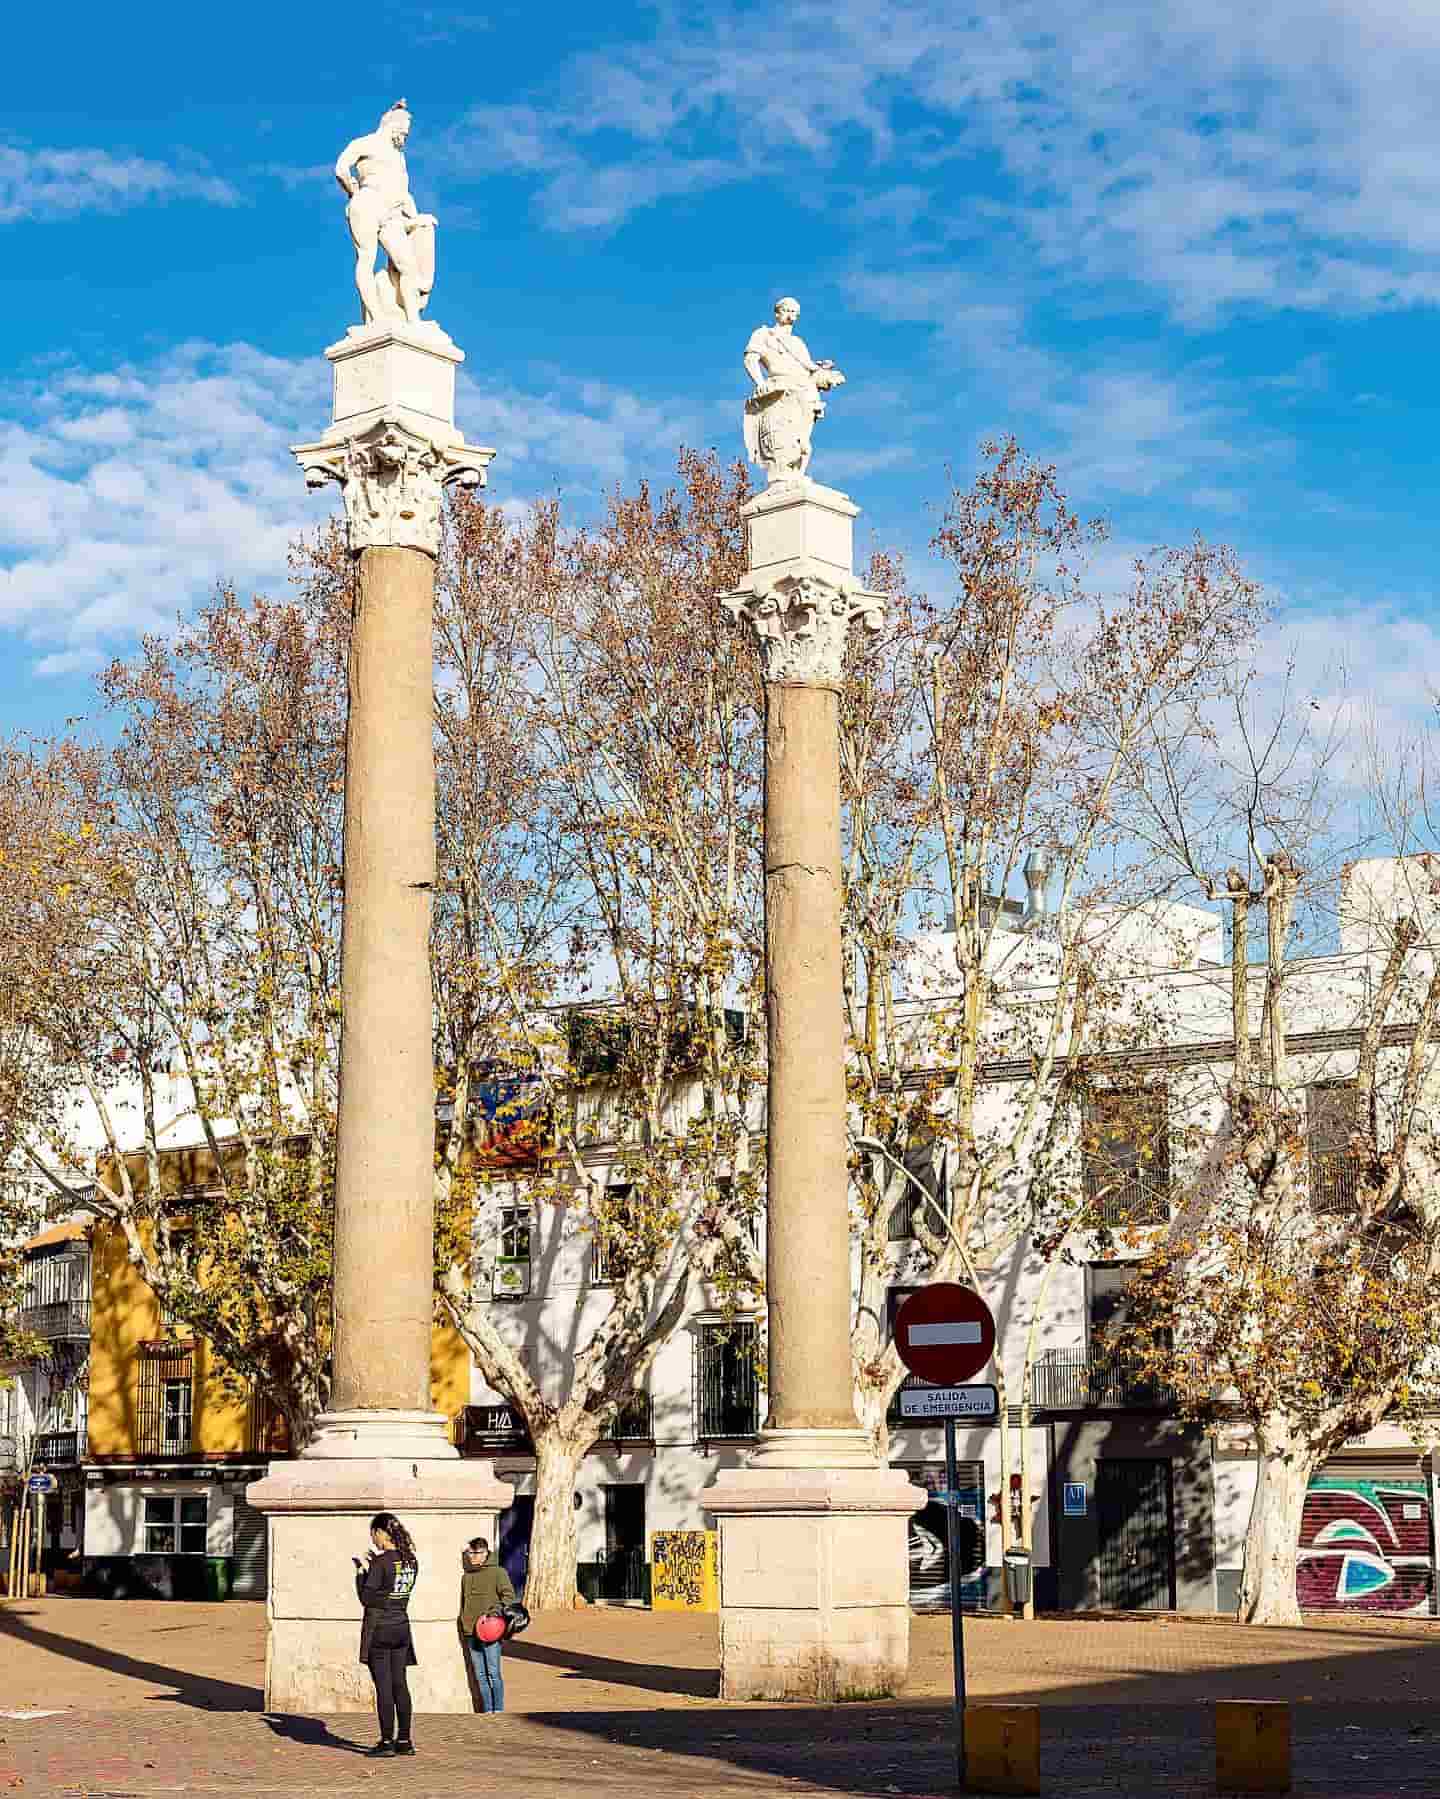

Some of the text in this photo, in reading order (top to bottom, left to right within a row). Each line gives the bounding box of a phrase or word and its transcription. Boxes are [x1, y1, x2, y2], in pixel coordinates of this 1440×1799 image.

[927, 1391, 968, 1401] SALIDA
[904, 1401, 992, 1414] DE EMERGENCIA
